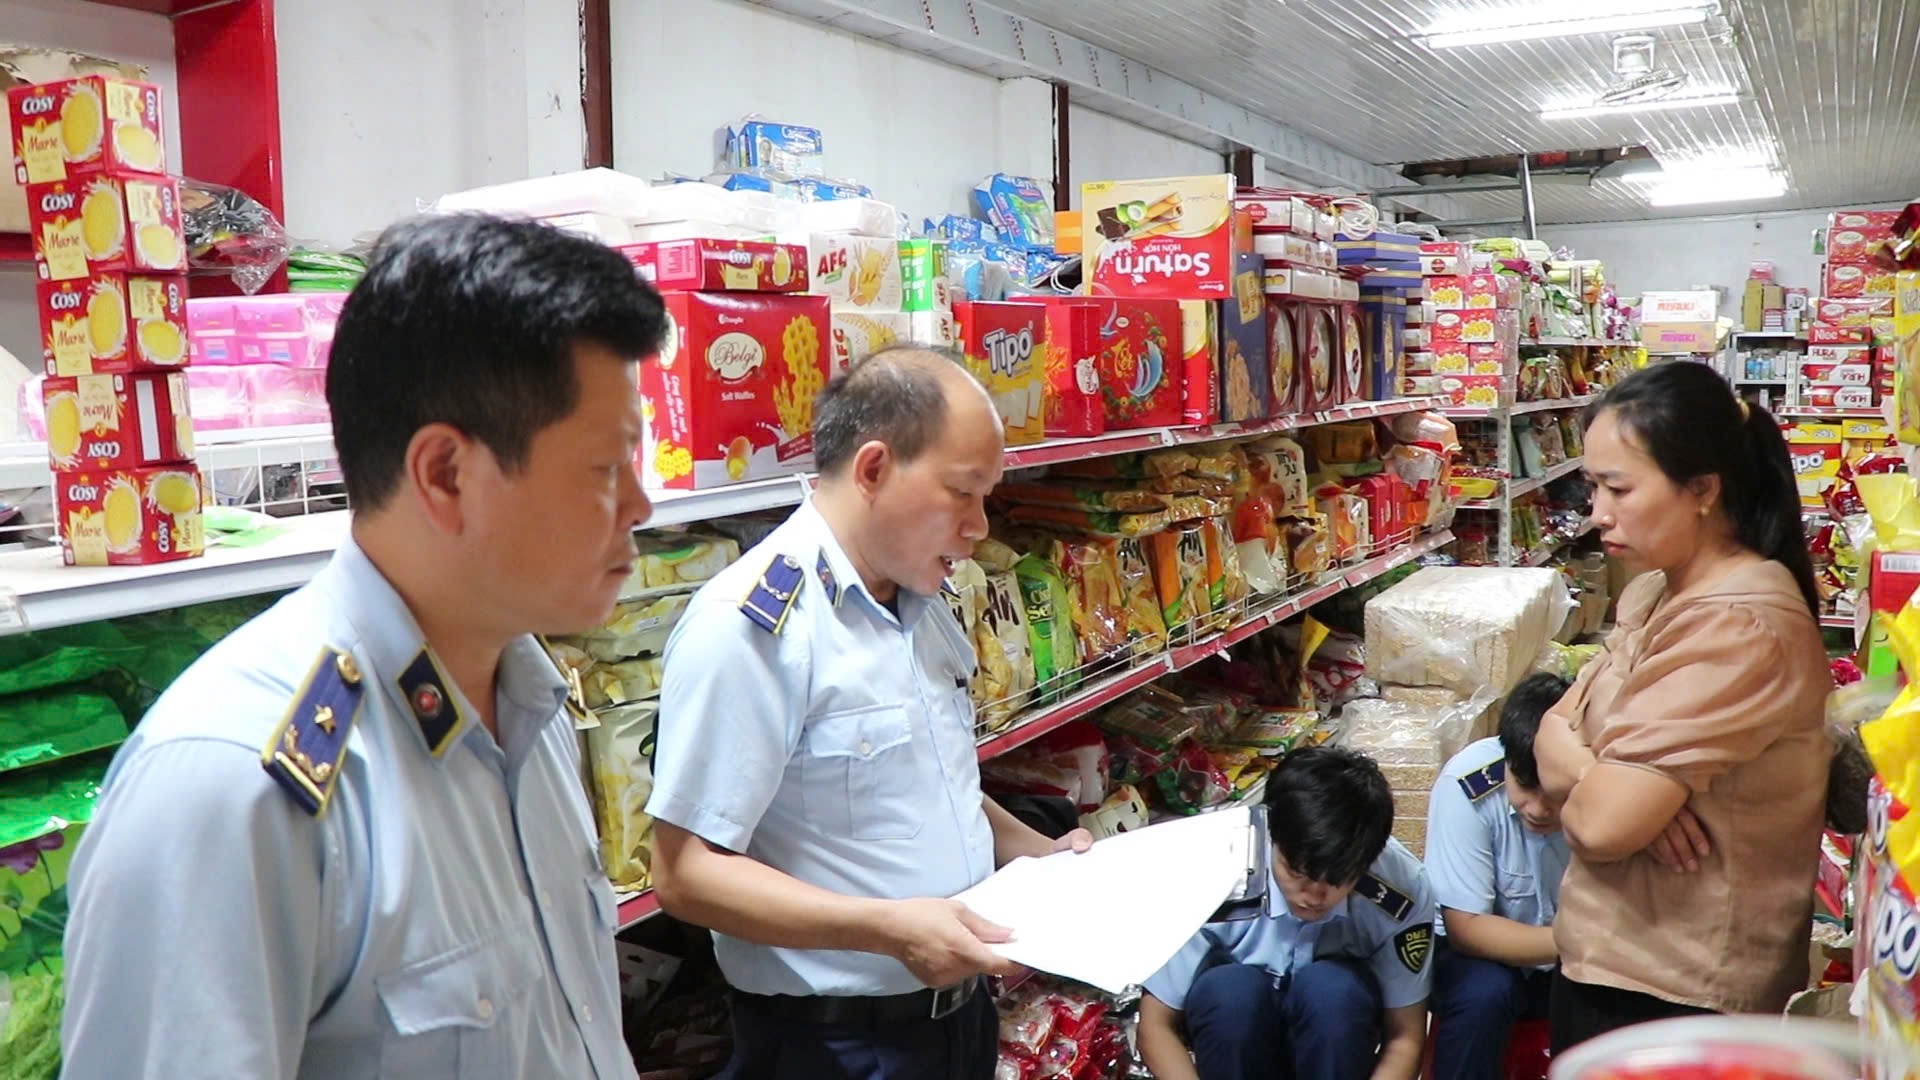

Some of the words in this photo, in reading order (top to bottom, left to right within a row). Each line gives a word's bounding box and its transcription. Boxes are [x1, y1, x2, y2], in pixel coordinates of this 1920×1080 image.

[816, 247, 847, 278] AFC
[1115, 252, 1211, 279] Saturn
[714, 341, 758, 371] Belgi
[984, 328, 1032, 378] Tipo
[1405, 928, 1428, 942] DMS
